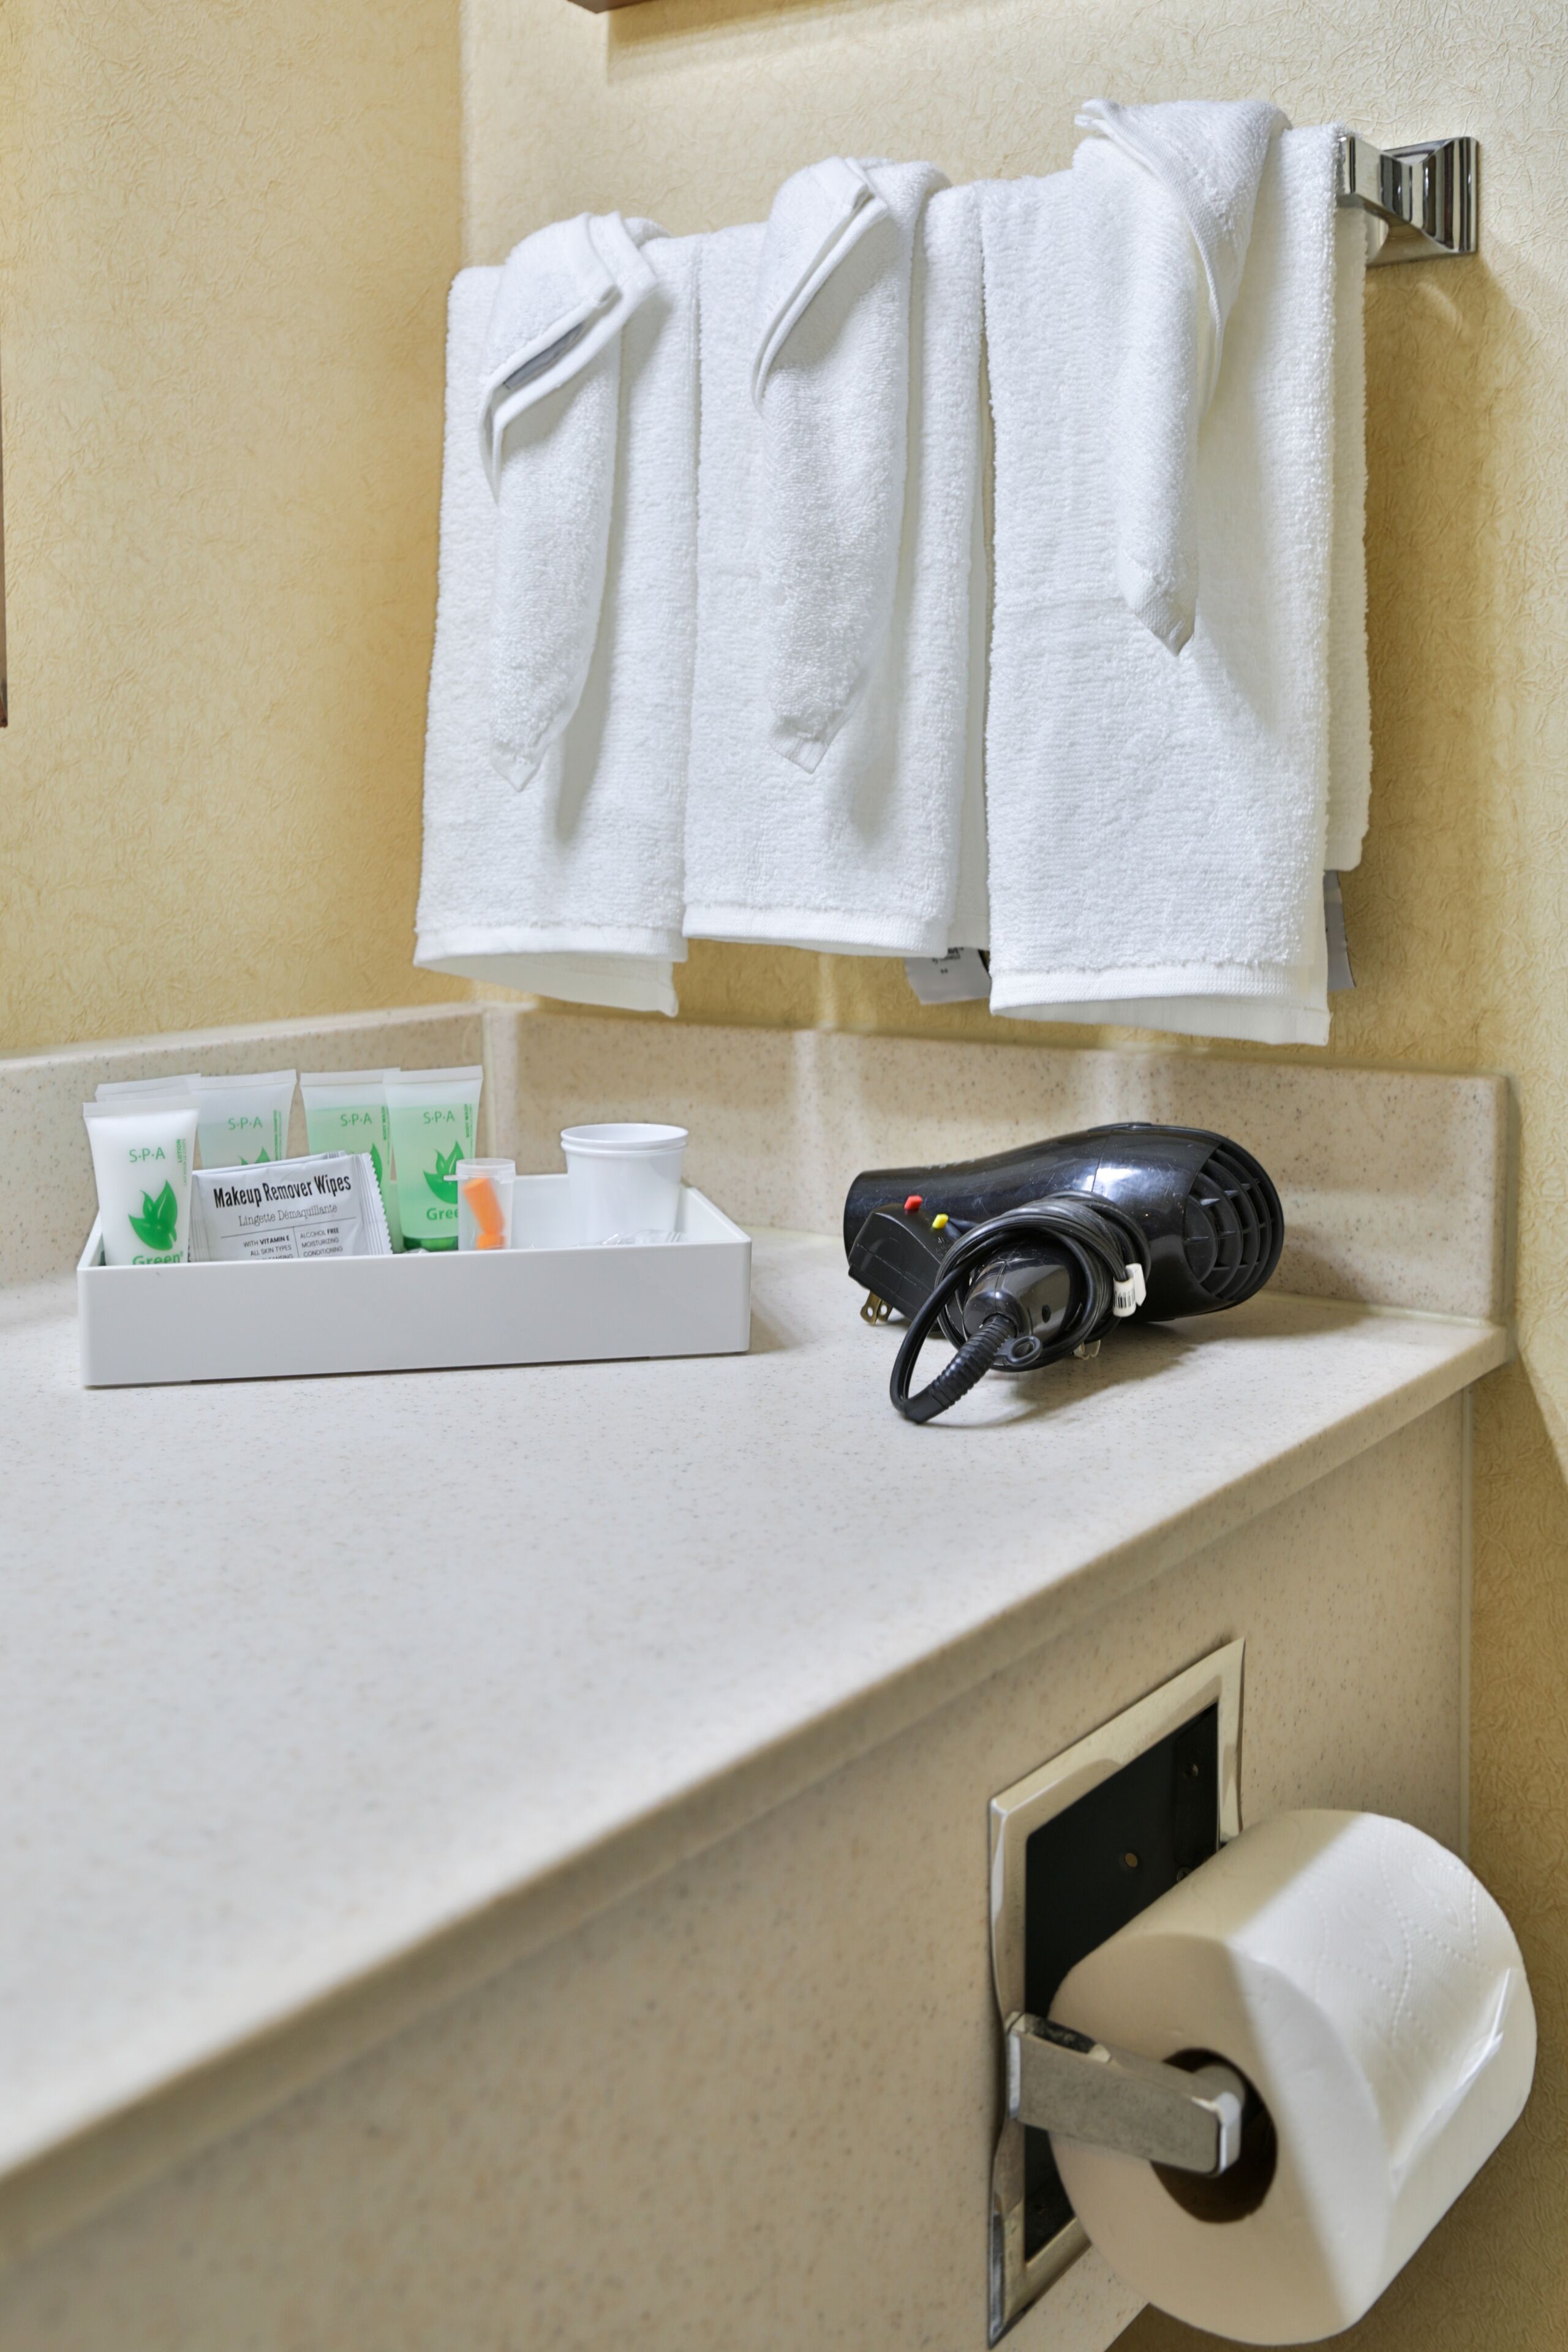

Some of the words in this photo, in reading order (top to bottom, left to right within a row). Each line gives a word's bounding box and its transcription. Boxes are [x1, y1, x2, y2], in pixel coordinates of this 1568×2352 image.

[213, 1186, 262, 1208] Makeup
[262, 1181, 313, 1202] Remover
[314, 1174, 352, 1197] Wipes
[238, 1213, 276, 1227] Lingette
[277, 1204, 337, 1220] Démaquillante
[426, 1207, 459, 1221] Gree
[259, 1236, 285, 1245] VITAMIN
[301, 1237, 339, 1248] MOISTURIZING
[276, 1244, 292, 1253] TYPES
[303, 1246, 343, 1257] CONDITIONING
